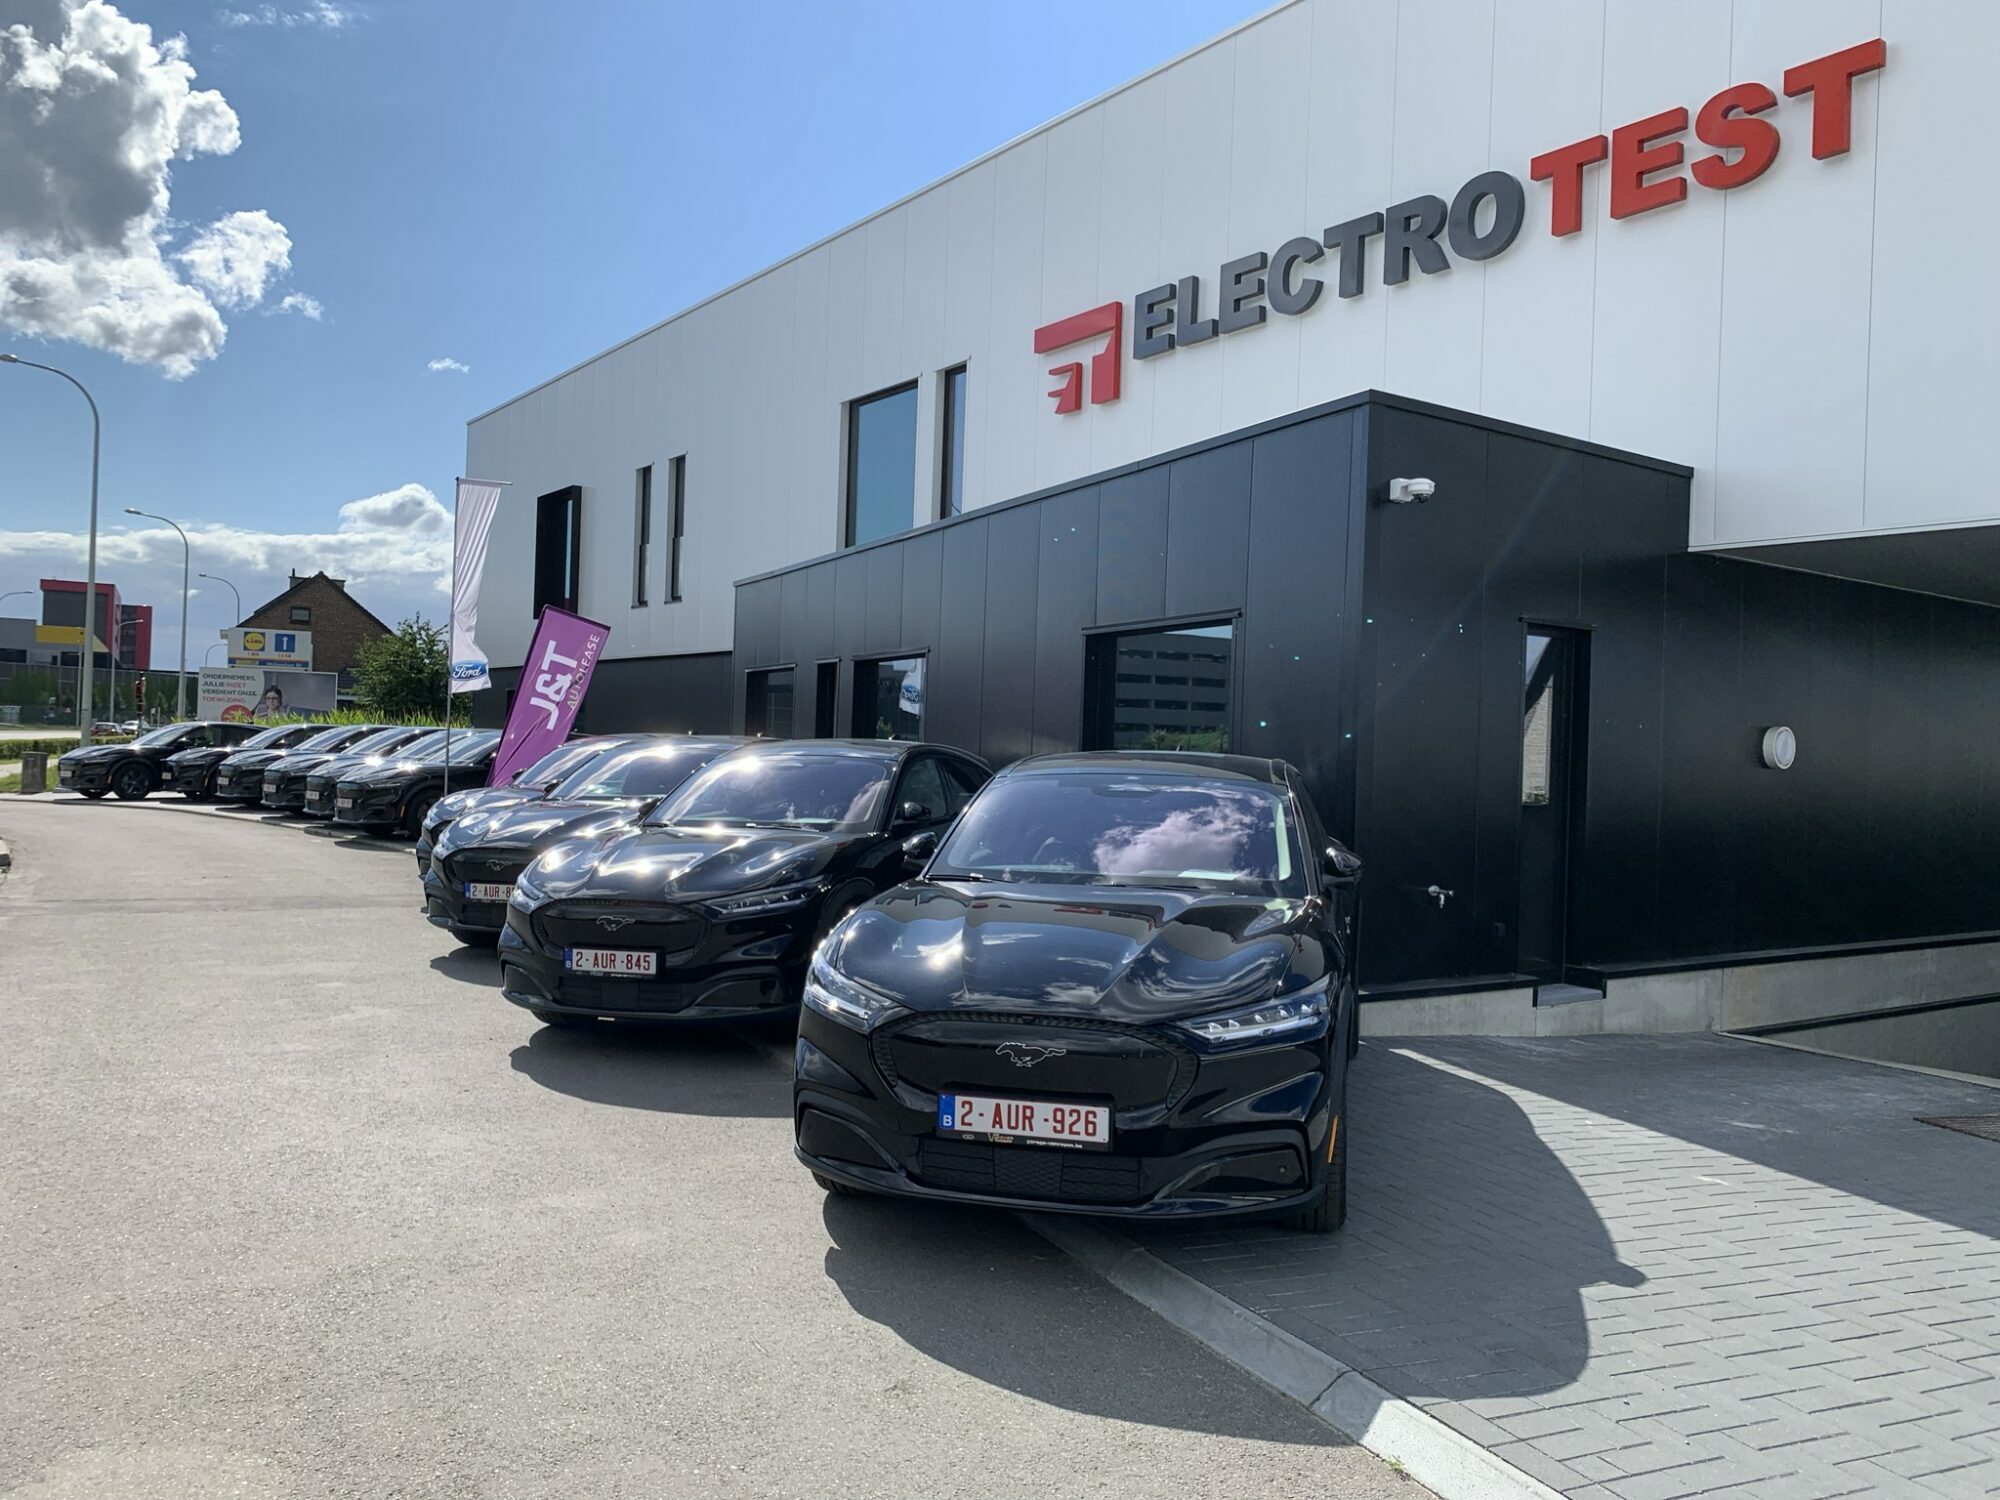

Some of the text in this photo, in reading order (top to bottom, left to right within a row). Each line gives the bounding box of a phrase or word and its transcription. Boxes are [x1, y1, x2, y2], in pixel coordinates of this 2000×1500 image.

[1133, 38, 1886, 360] ELECTROTEST
[452, 663, 482, 679] Ford
[529, 639, 578, 731] J&T
[567, 633, 601, 710] AUTOLEASE
[942, 1115, 952, 1126] B
